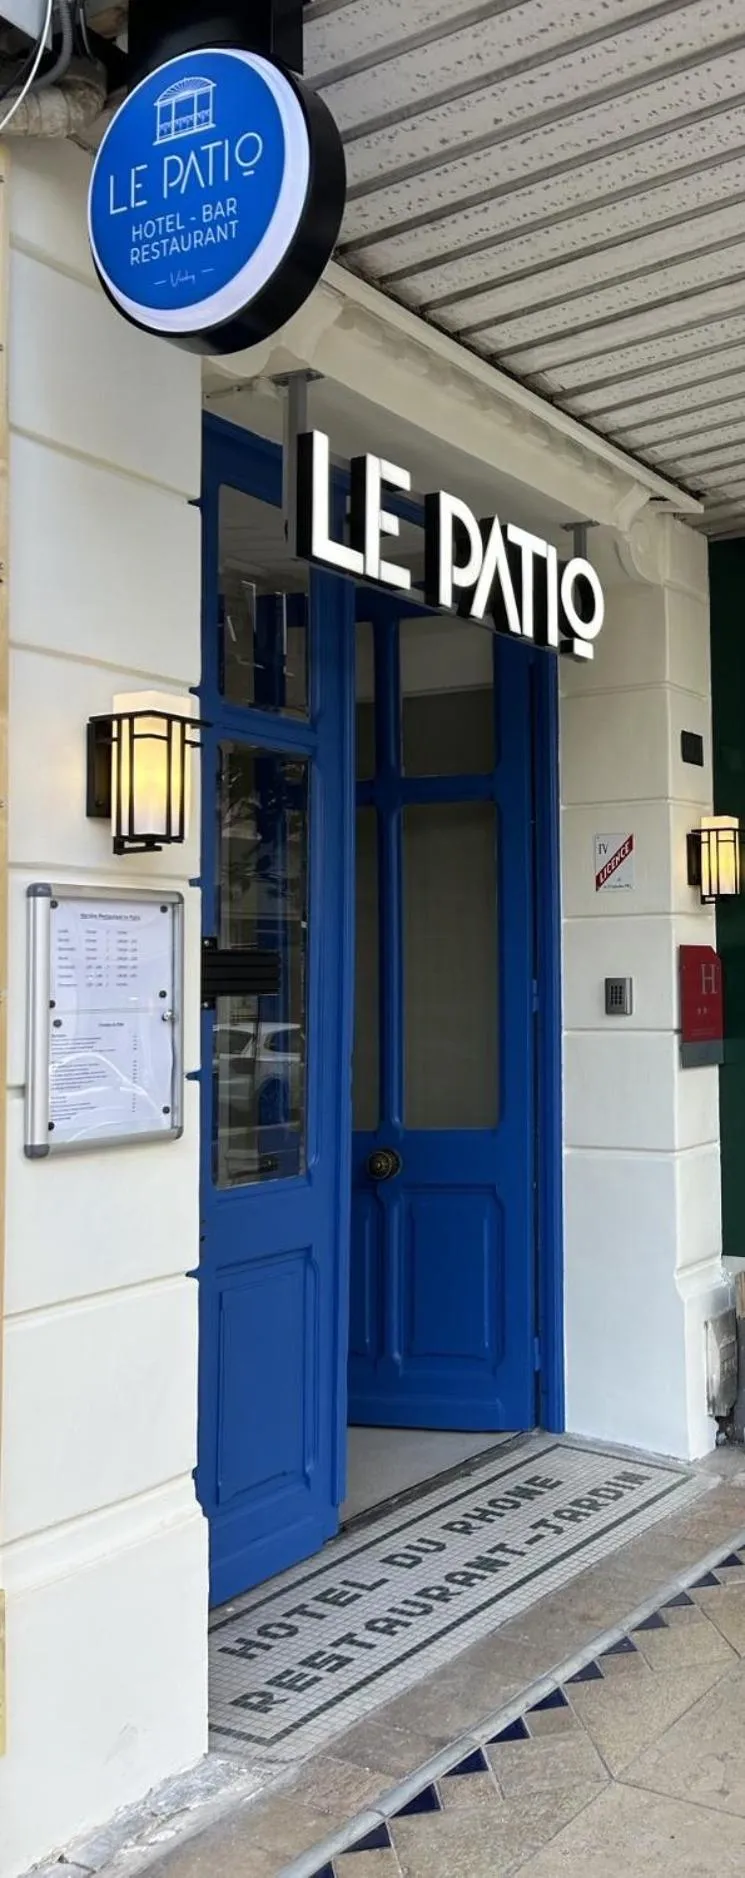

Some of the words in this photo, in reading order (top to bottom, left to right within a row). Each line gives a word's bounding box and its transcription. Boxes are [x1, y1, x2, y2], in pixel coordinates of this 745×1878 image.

[109, 163, 149, 216] LE
[162, 131, 264, 199] PATIO
[129, 219, 240, 266] RESTAURANT
[131, 211, 186, 243] HOTEL
[202, 197, 238, 224] BAR
[311, 429, 412, 591] LE
[438, 489, 605, 660] PATIO
[598, 843, 608, 854] IV
[599, 843, 631, 883] LICENCE
[701, 963, 718, 995] H
[217, 1577, 390, 1661] HOTEL
[380, 1536, 448, 1570] DU
[442, 1474, 565, 1536] RHONE
